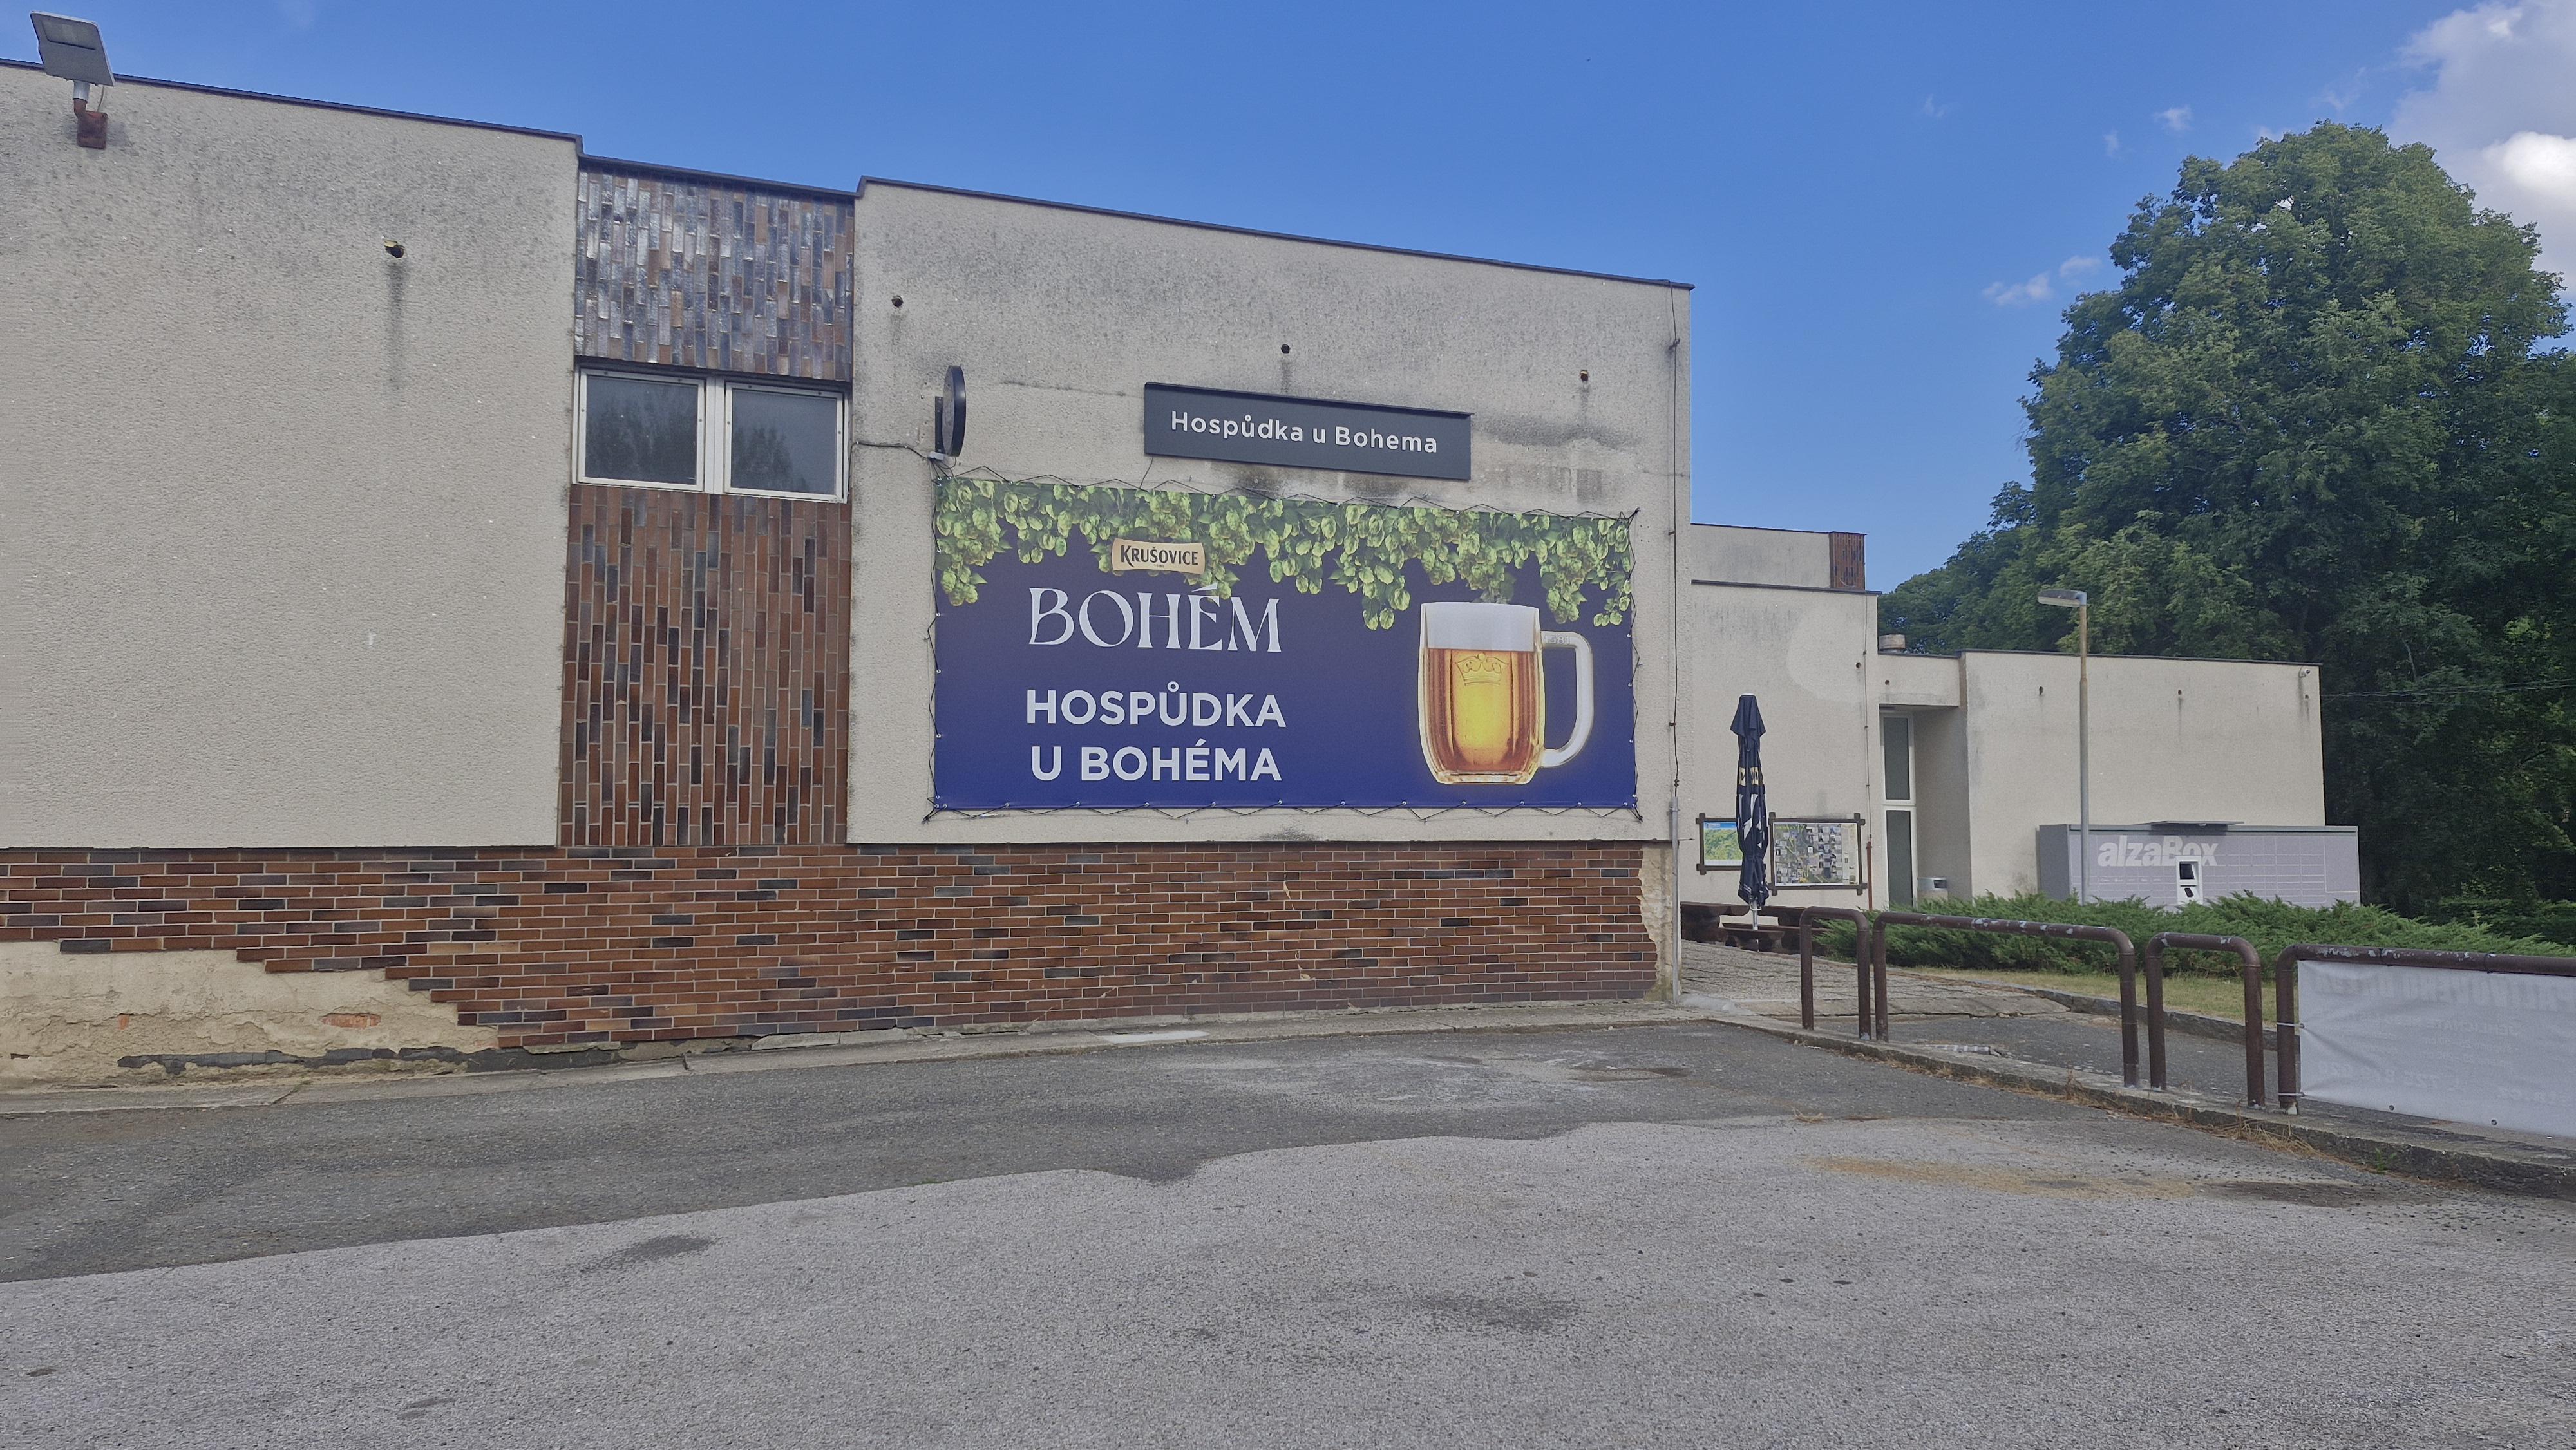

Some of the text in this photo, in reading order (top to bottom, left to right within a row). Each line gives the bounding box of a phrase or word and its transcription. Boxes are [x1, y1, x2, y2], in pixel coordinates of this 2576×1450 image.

[1171, 410, 1437, 453] Hospůdka u Bohema
[1028, 583, 1282, 652] BOHÉM
[1544, 635, 1570, 644] 1581
[1027, 681, 1286, 728] HOSPŮDKA
[1032, 738, 1282, 781] U BOHÉMA
[2097, 835, 2219, 867] alzaBox
